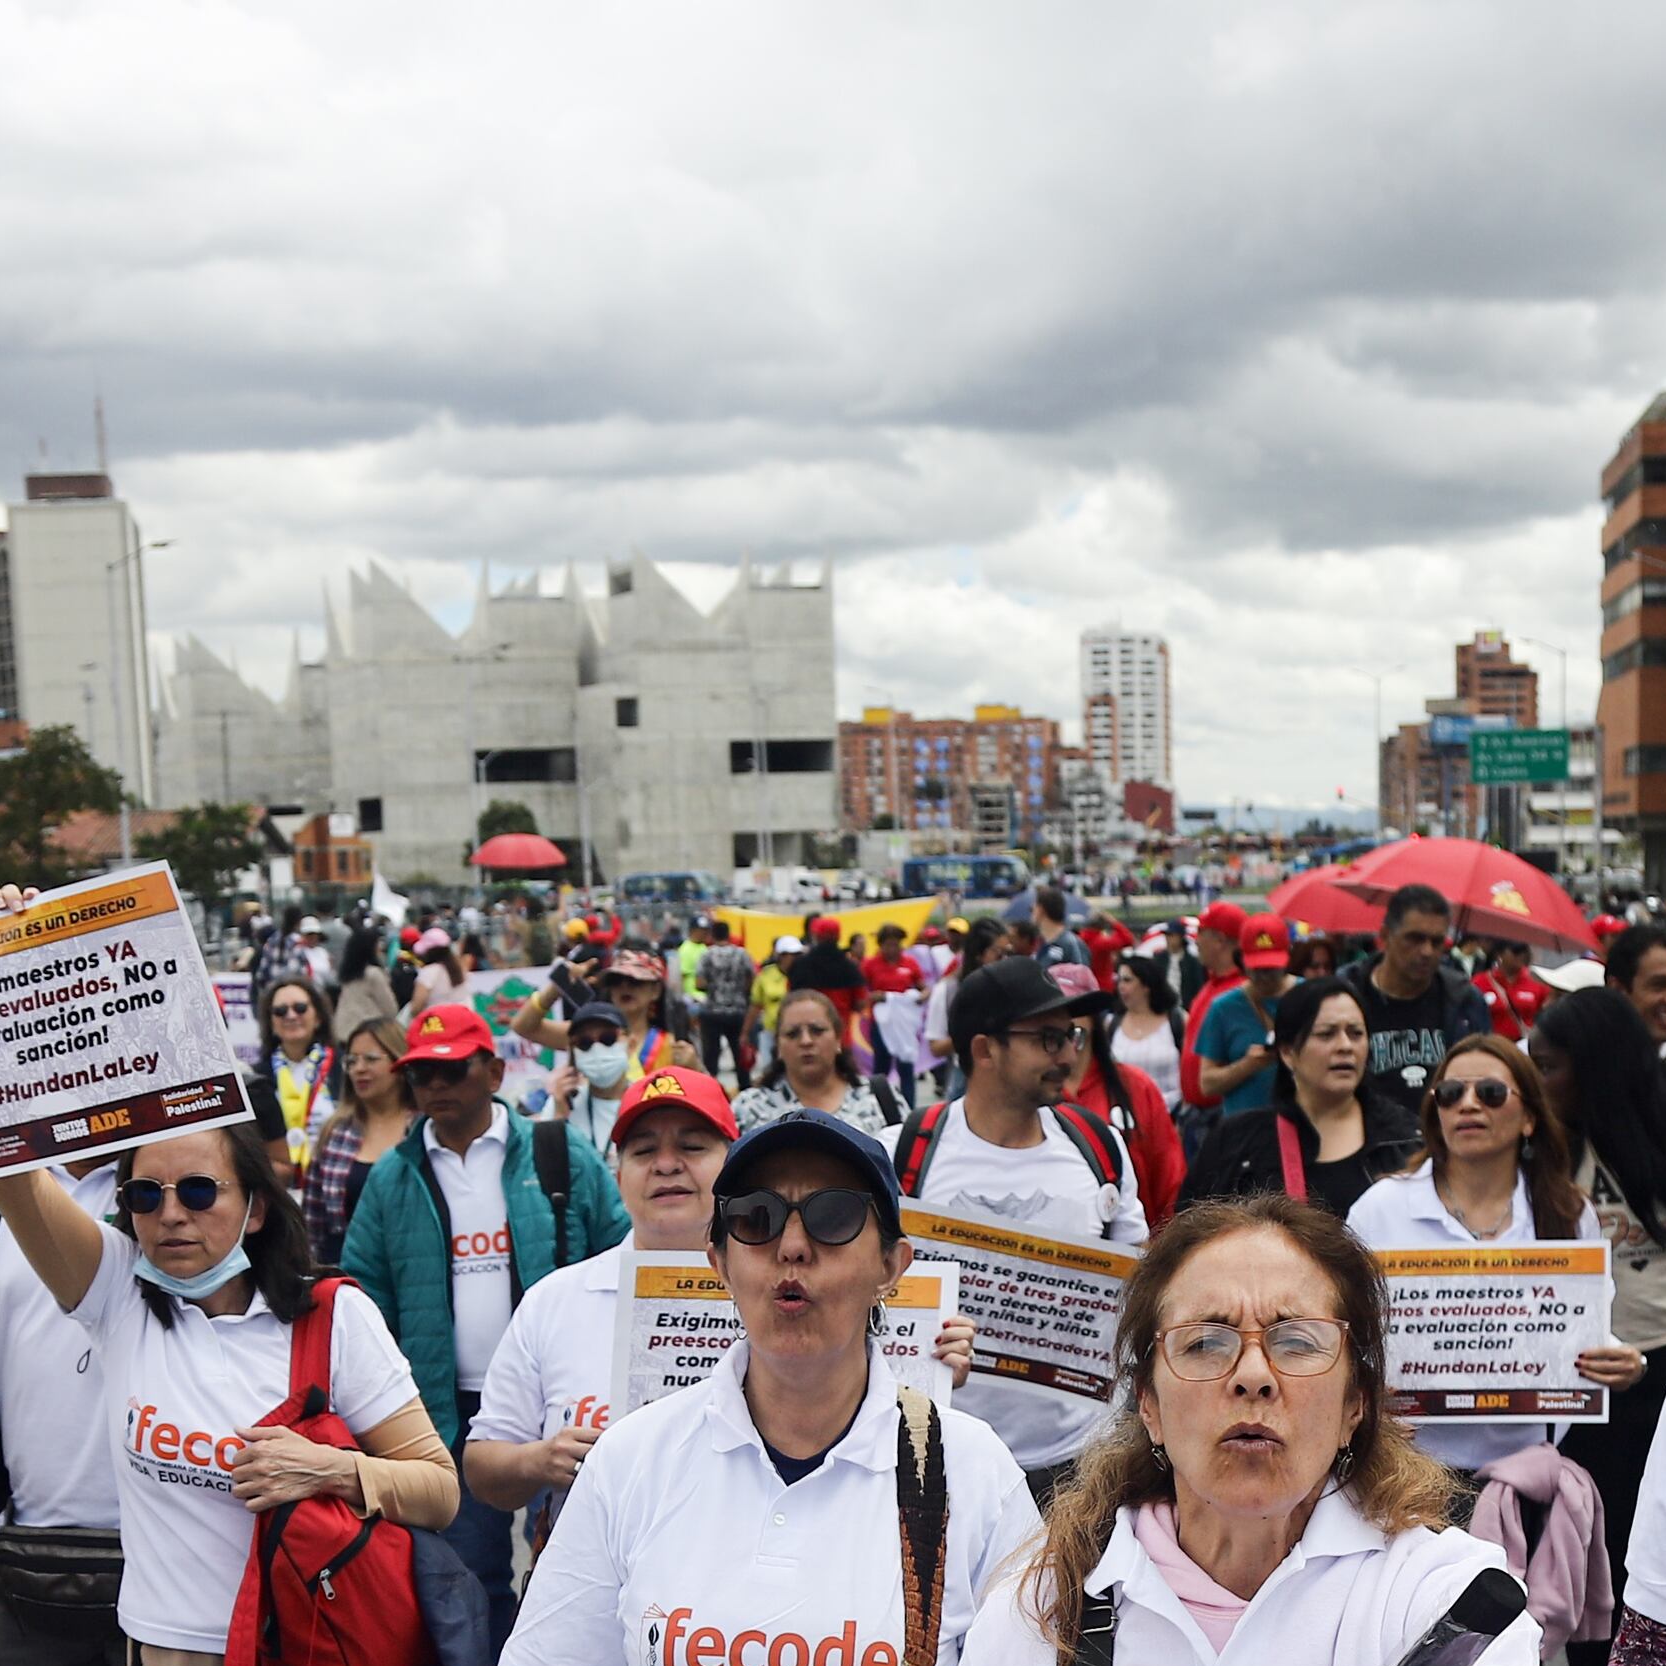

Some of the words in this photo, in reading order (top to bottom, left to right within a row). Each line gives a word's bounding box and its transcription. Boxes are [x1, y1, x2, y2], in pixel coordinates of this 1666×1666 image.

[69, 896, 136, 923] DERECHO
[104, 939, 138, 964] YA
[123, 960, 158, 986] NO
[163, 958, 178, 976] a
[101, 988, 166, 1018] como
[16, 1025, 110, 1066] sanción!
[1370, 1028, 1446, 1075] HICA
[164, 1094, 223, 1118] Palestina!
[89, 1108, 132, 1135] ADE
[452, 1221, 513, 1258] cod
[453, 1262, 501, 1276] UCACIÓN
[1056, 1248, 1112, 1269] DERECHO
[1511, 1256, 1571, 1268] DERECHO
[676, 1279, 695, 1291] LA
[993, 1265, 1013, 1278] se
[1016, 1268, 1100, 1296] garantice
[1104, 1286, 1120, 1300] el
[1393, 1287, 1429, 1304] ¡Los
[1435, 1285, 1524, 1300] maestros
[1532, 1285, 1555, 1299] YA
[973, 1292, 996, 1305] un
[1000, 1296, 1070, 1321] derecho
[1073, 1309, 1096, 1325] de
[998, 1280, 1019, 1295] de
[1024, 1285, 1057, 1302] tres
[1061, 1293, 1120, 1315] grados
[988, 1305, 1035, 1326] niños
[1039, 1318, 1051, 1332] y
[1053, 1319, 1101, 1340] niñas
[1385, 1305, 1424, 1318] mos
[1430, 1302, 1533, 1319] evaluados,
[1538, 1302, 1567, 1317] NO
[1573, 1304, 1585, 1316] a
[896, 1321, 916, 1338] el
[1404, 1318, 1508, 1335] evaluación
[1513, 1321, 1567, 1334] como
[648, 1333, 732, 1352] preesco
[882, 1340, 920, 1358] dos
[974, 1325, 1112, 1363] rDeTresGradosYA
[1433, 1336, 1515, 1352] sanción!
[675, 1355, 720, 1369] com
[996, 1357, 1030, 1375] ADE
[1399, 1360, 1547, 1378] #HundanLaLey
[1476, 1393, 1510, 1409] ADE
[134, 1404, 247, 1473] feco
[157, 1469, 233, 1494] EDUCACI
